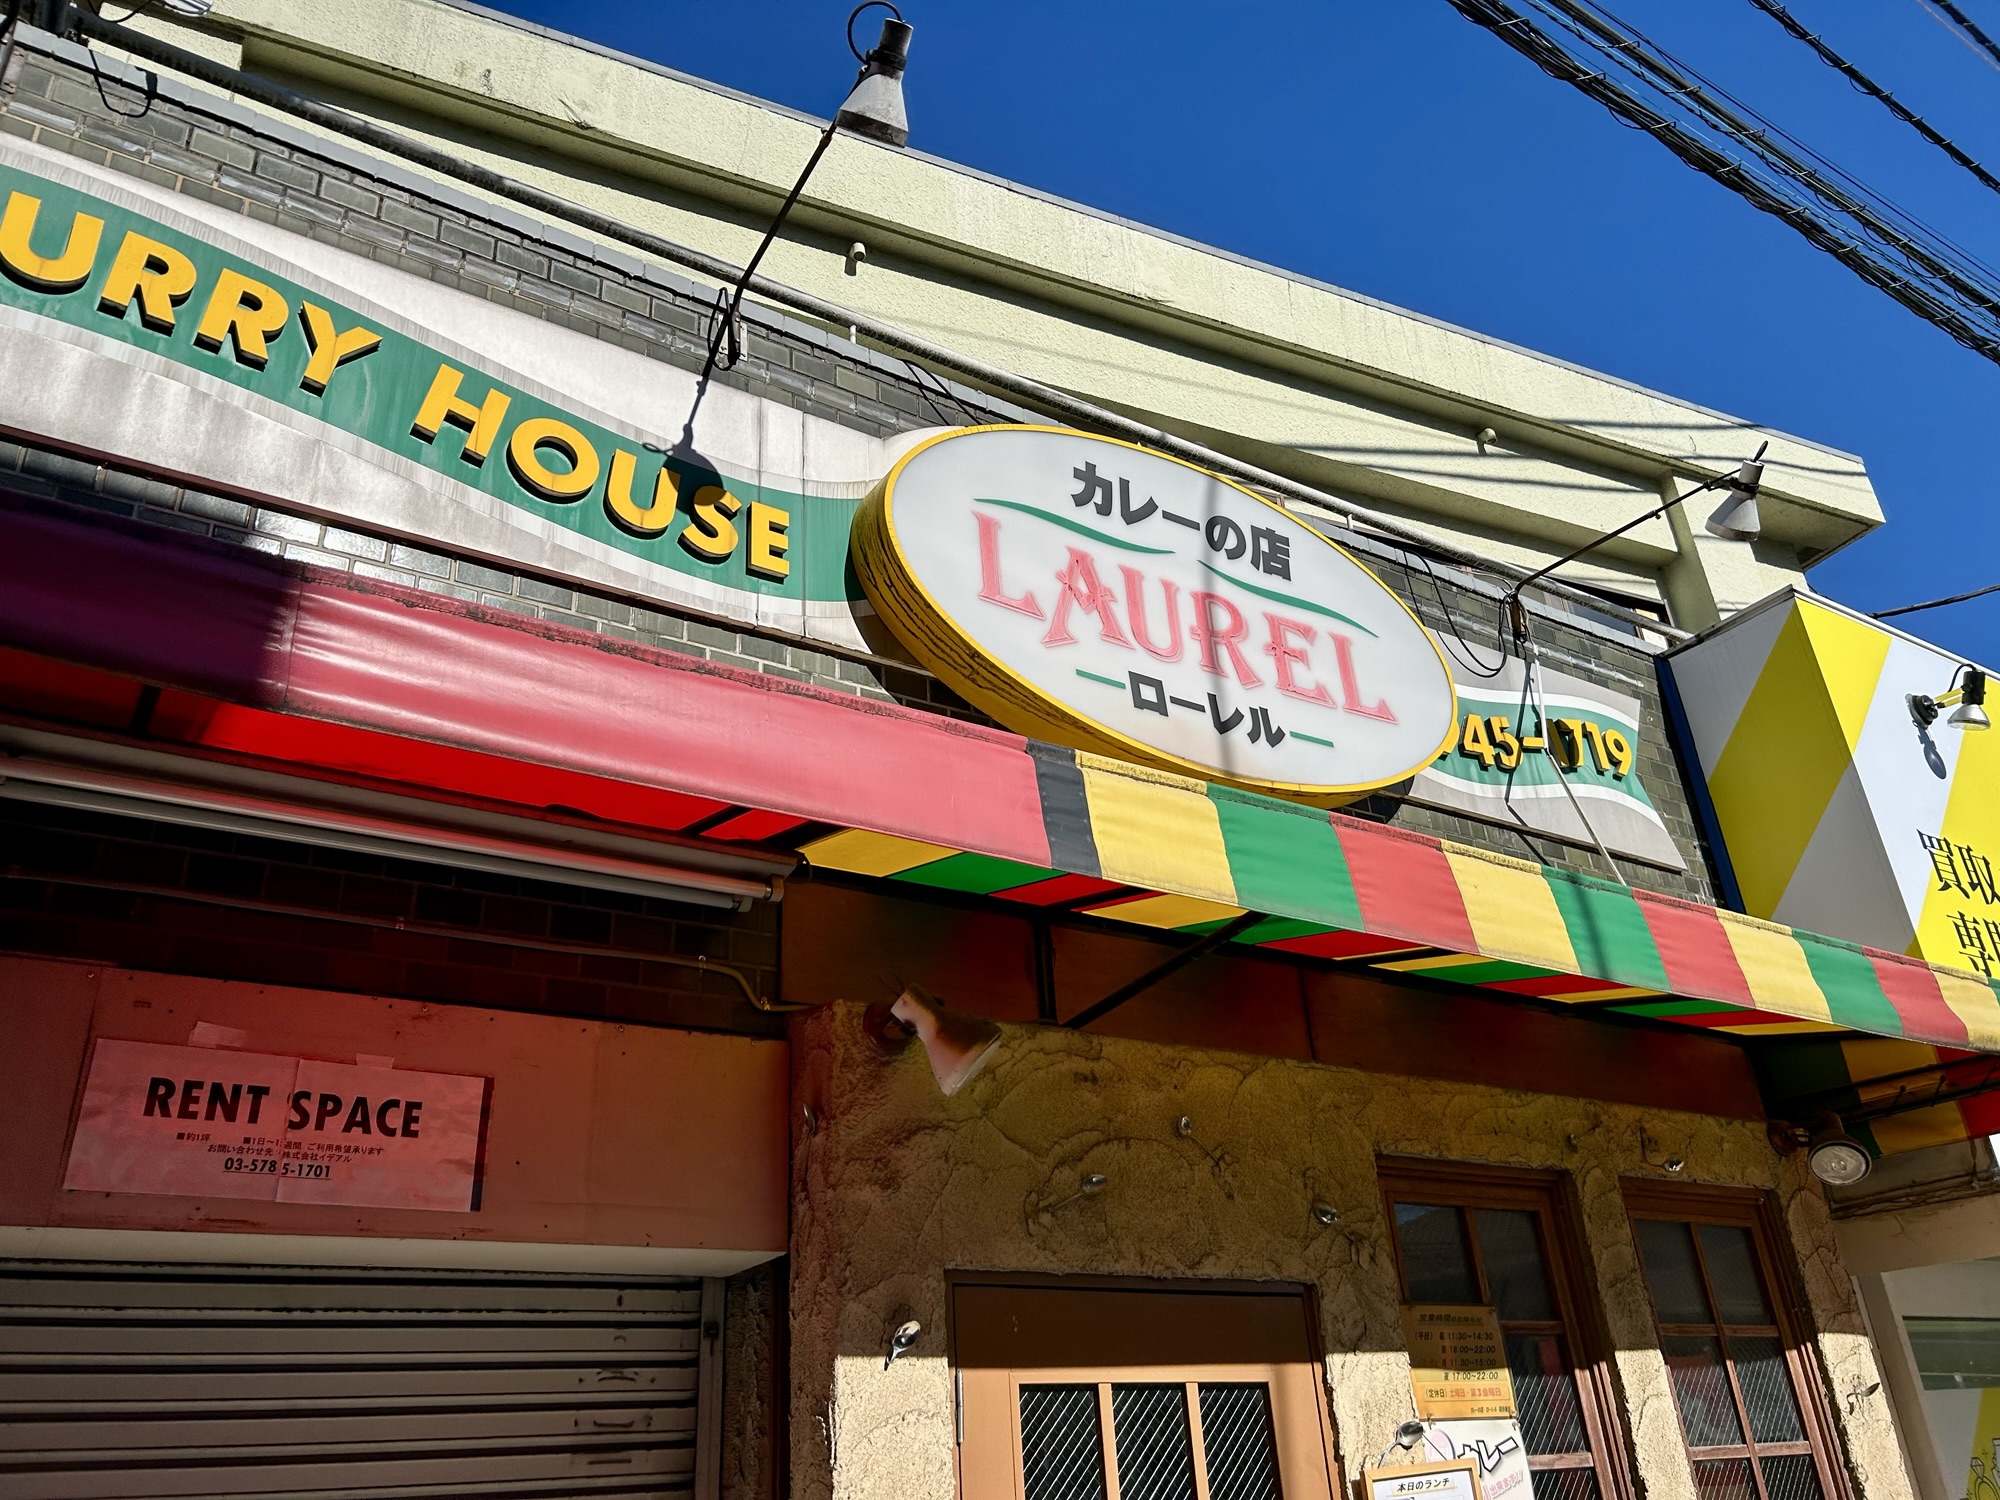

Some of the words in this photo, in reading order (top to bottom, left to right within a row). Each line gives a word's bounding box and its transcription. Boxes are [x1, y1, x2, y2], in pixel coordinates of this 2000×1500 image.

[0, 191, 382, 394] URRY
[411, 363, 791, 579] HOUSE
[1071, 461, 1292, 582] カレーの店
[972, 511, 1398, 725] LAUREL
[1128, 670, 1286, 748] ローレル
[1443, 713, 1633, 777] 45-1719
[143, 1077, 271, 1125] RENT
[287, 1090, 423, 1138] SPACE
[224, 1156, 331, 1178] 03-5785-1701
[307, 1142, 384, 1156] ご利用希望承ります
[1397, 1477, 1450, 1493] 本日のランチ
